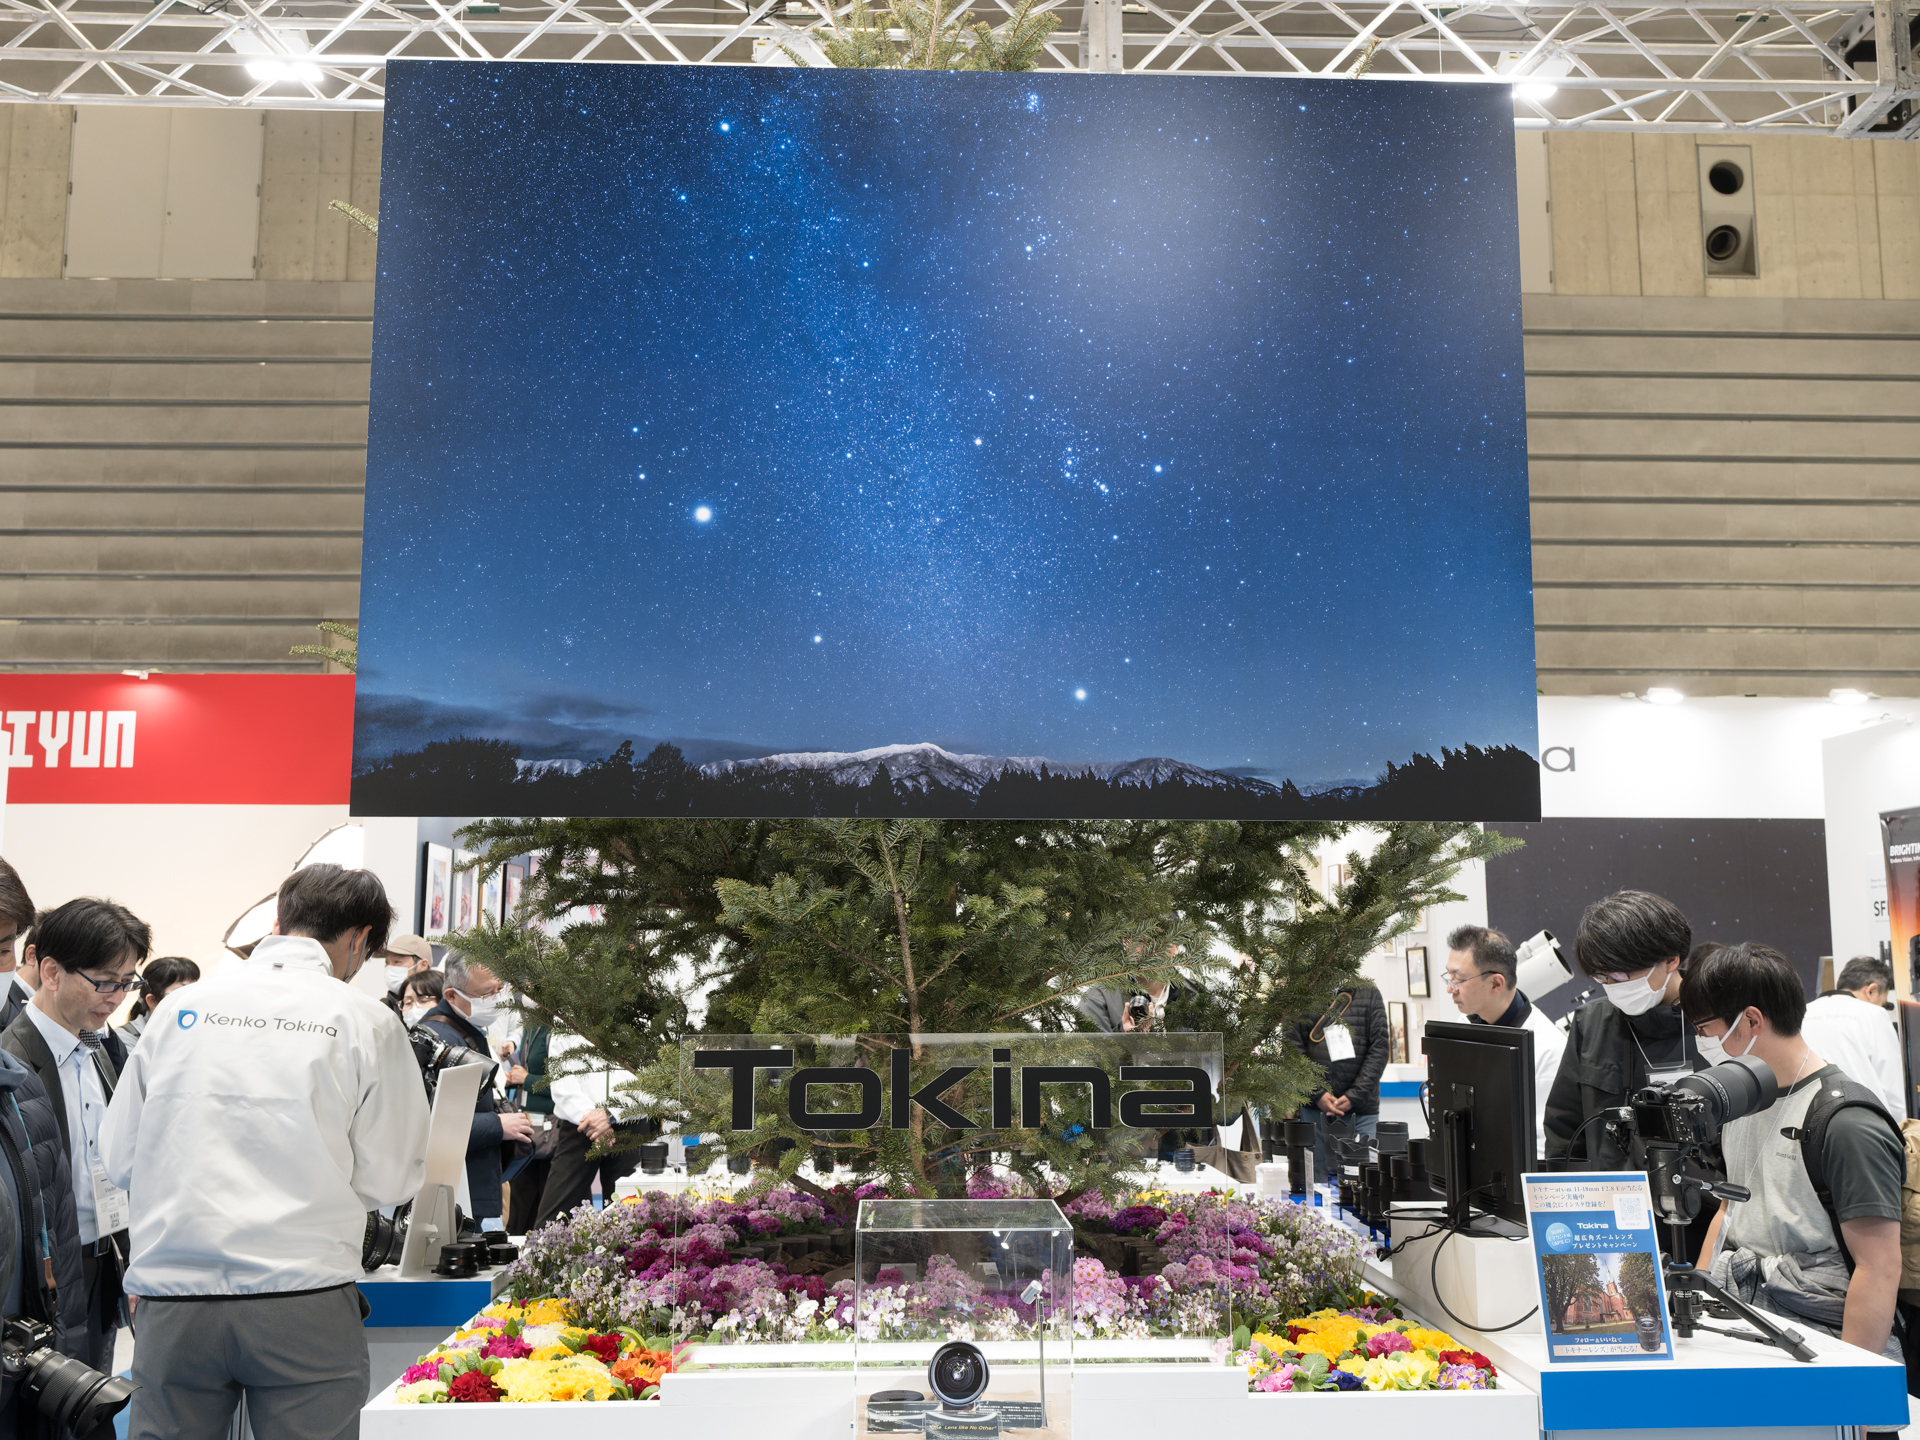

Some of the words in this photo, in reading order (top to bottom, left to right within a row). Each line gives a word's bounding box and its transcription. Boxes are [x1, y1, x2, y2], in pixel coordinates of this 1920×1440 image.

[0, 711, 137, 768] IYUN
[204, 1012, 267, 1029] Kenko
[273, 1017, 338, 1038] Tokina
[694, 1048, 1213, 1131] Tokina
[1572, 1241, 1638, 1249] プレゼントキャンペーン
[1574, 1233, 1633, 1241] 超広角ズームレンズ
